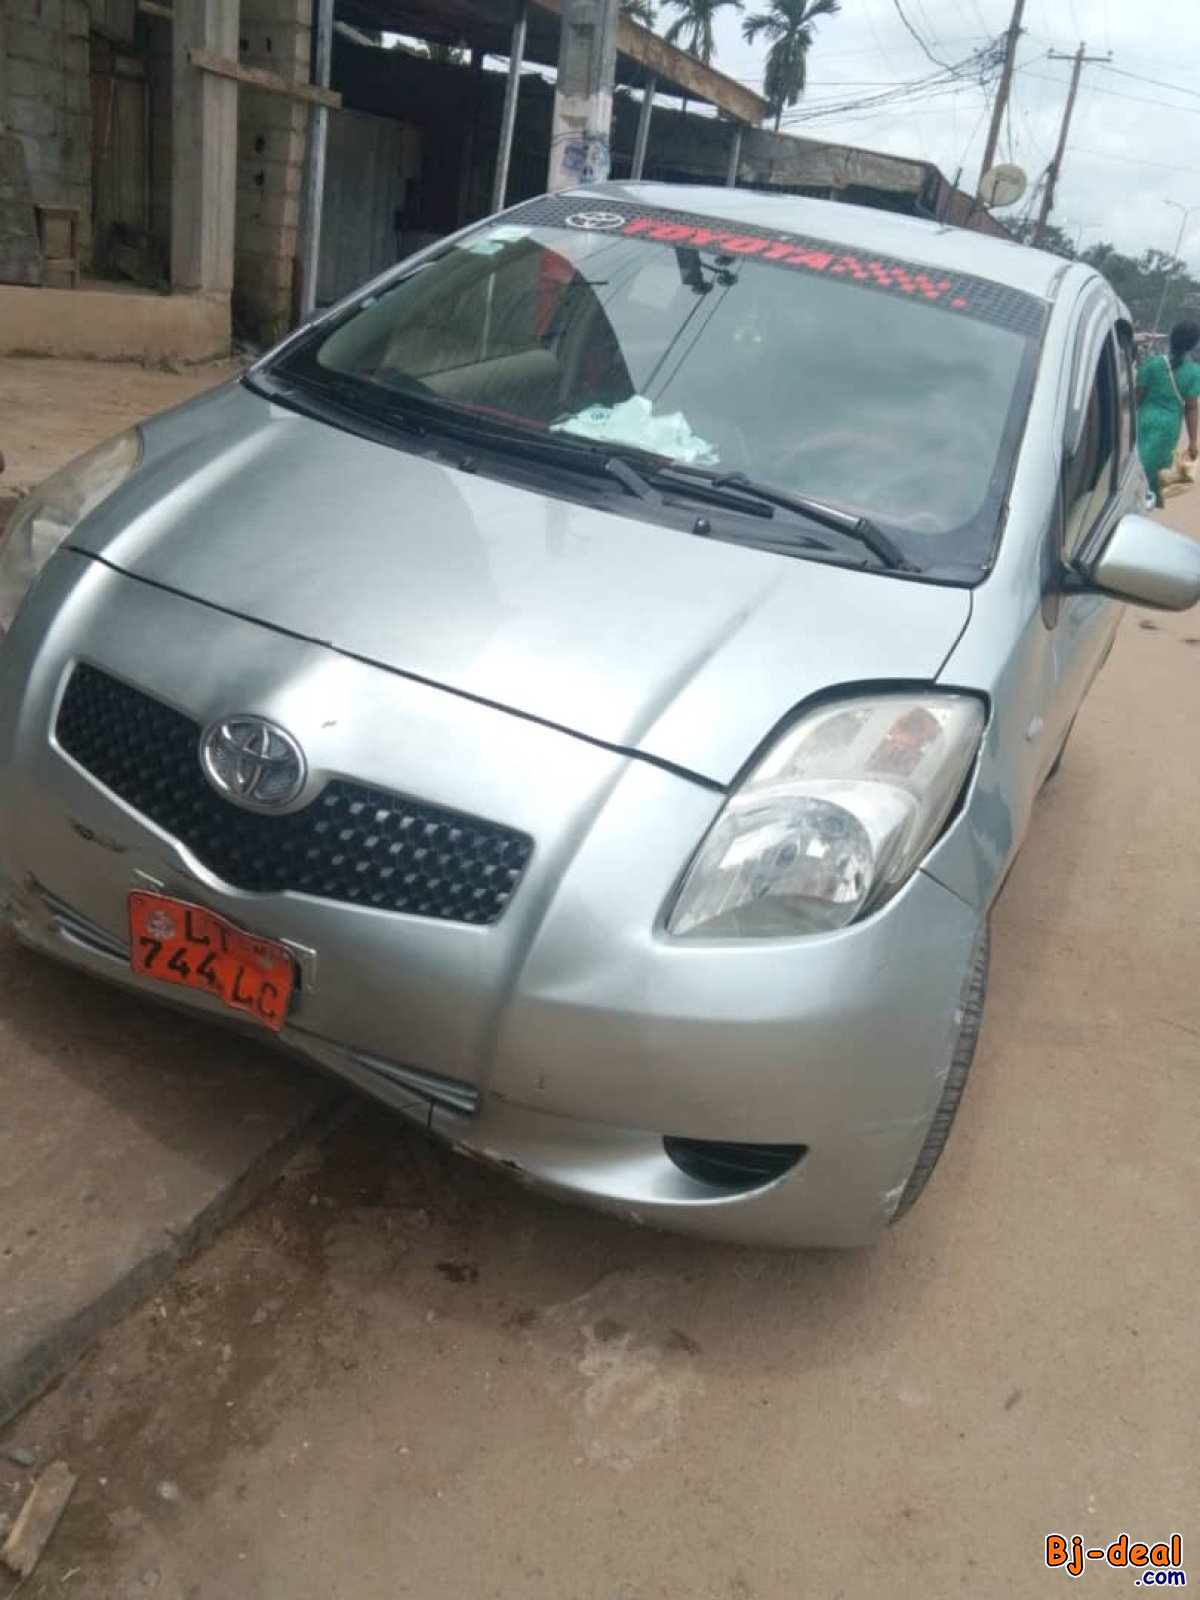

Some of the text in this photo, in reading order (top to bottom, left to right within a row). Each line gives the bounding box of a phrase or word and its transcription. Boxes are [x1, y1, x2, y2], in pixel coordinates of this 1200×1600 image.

[622, 217, 832, 271] TOYOTA
[184, 910, 229, 953] LT
[139, 936, 278, 1018] 744 LC
